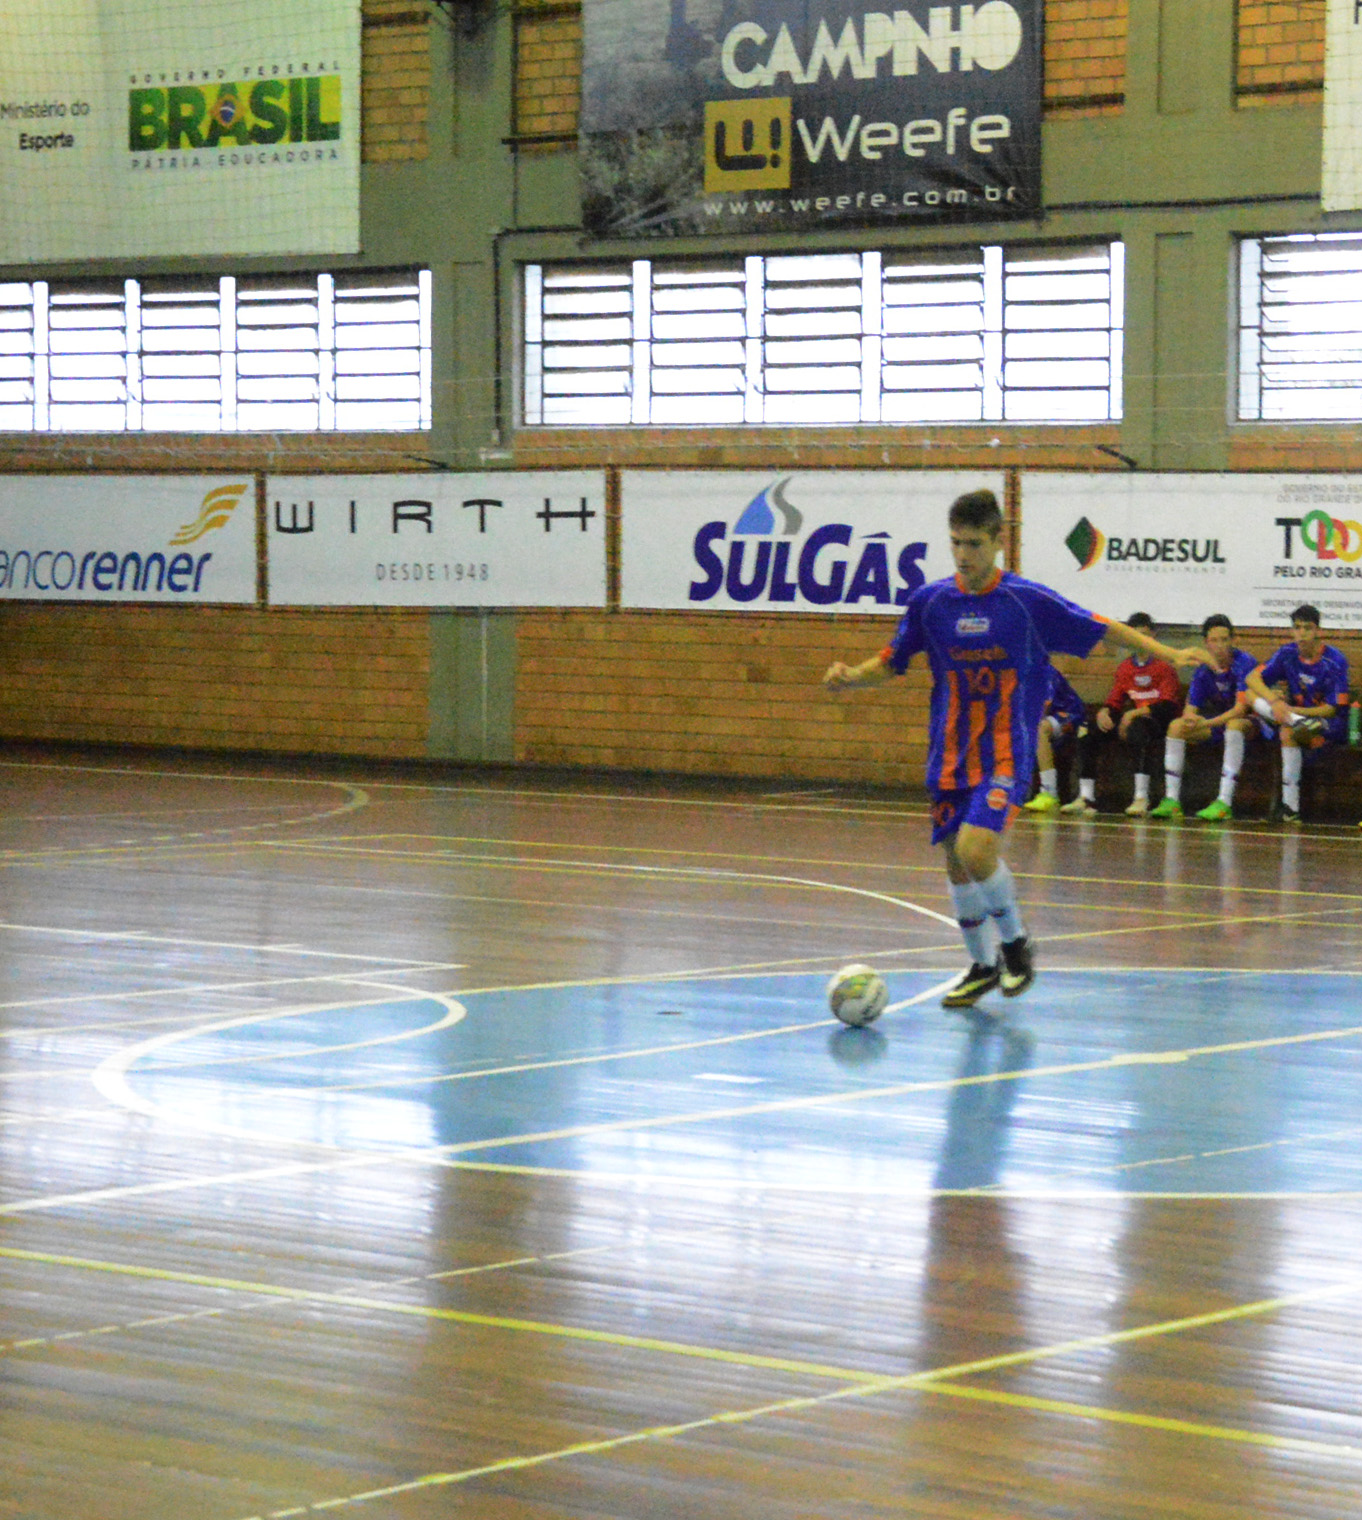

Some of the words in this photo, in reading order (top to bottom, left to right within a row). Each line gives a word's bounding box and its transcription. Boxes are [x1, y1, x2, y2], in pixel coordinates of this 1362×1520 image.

[720, 0, 1022, 89] CAMPINHO
[243, 60, 341, 76] FEDERAL
[70, 99, 90, 116] do
[129, 75, 341, 152] BRASIL
[19, 132, 75, 152] Esporte
[797, 107, 1012, 163] Weefe
[218, 149, 339, 166] EDUCADORA
[704, 184, 1017, 217] www.weefe.com.br
[275, 497, 597, 534] WIRTH
[1106, 538, 1226, 563] BADESUL
[376, 562, 436, 582] DESDE
[443, 562, 490, 582] 1948
[1273, 566, 1307, 578] PELO
[1309, 566, 1333, 578] RIO
